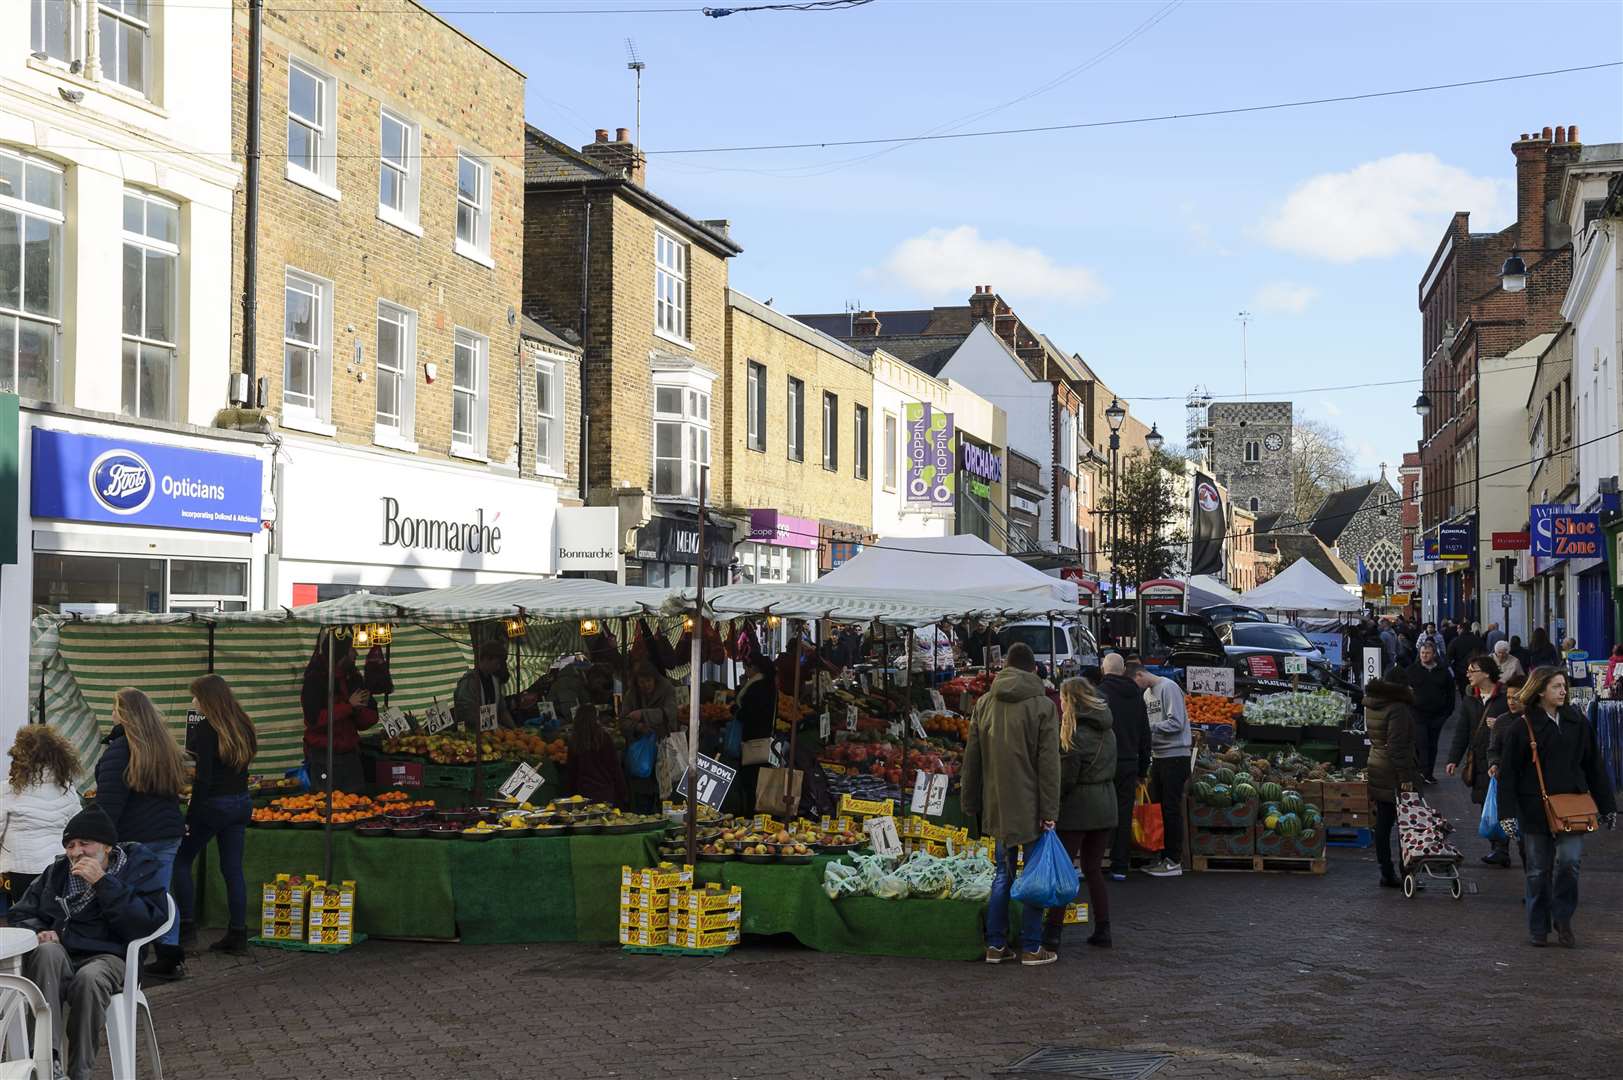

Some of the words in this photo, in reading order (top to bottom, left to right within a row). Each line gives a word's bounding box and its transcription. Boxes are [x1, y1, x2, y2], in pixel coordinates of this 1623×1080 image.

[914, 403, 925, 476] SHOPPING
[937, 414, 947, 483] SHOPPING
[103, 463, 146, 498] Boots
[162, 475, 225, 501] Opticians
[380, 496, 501, 554] Bonmarché
[1555, 517, 1596, 535] Shoe
[559, 548, 613, 559] Bonmarché
[1555, 537, 1596, 554] Zone
[710, 764, 732, 781] BOWL
